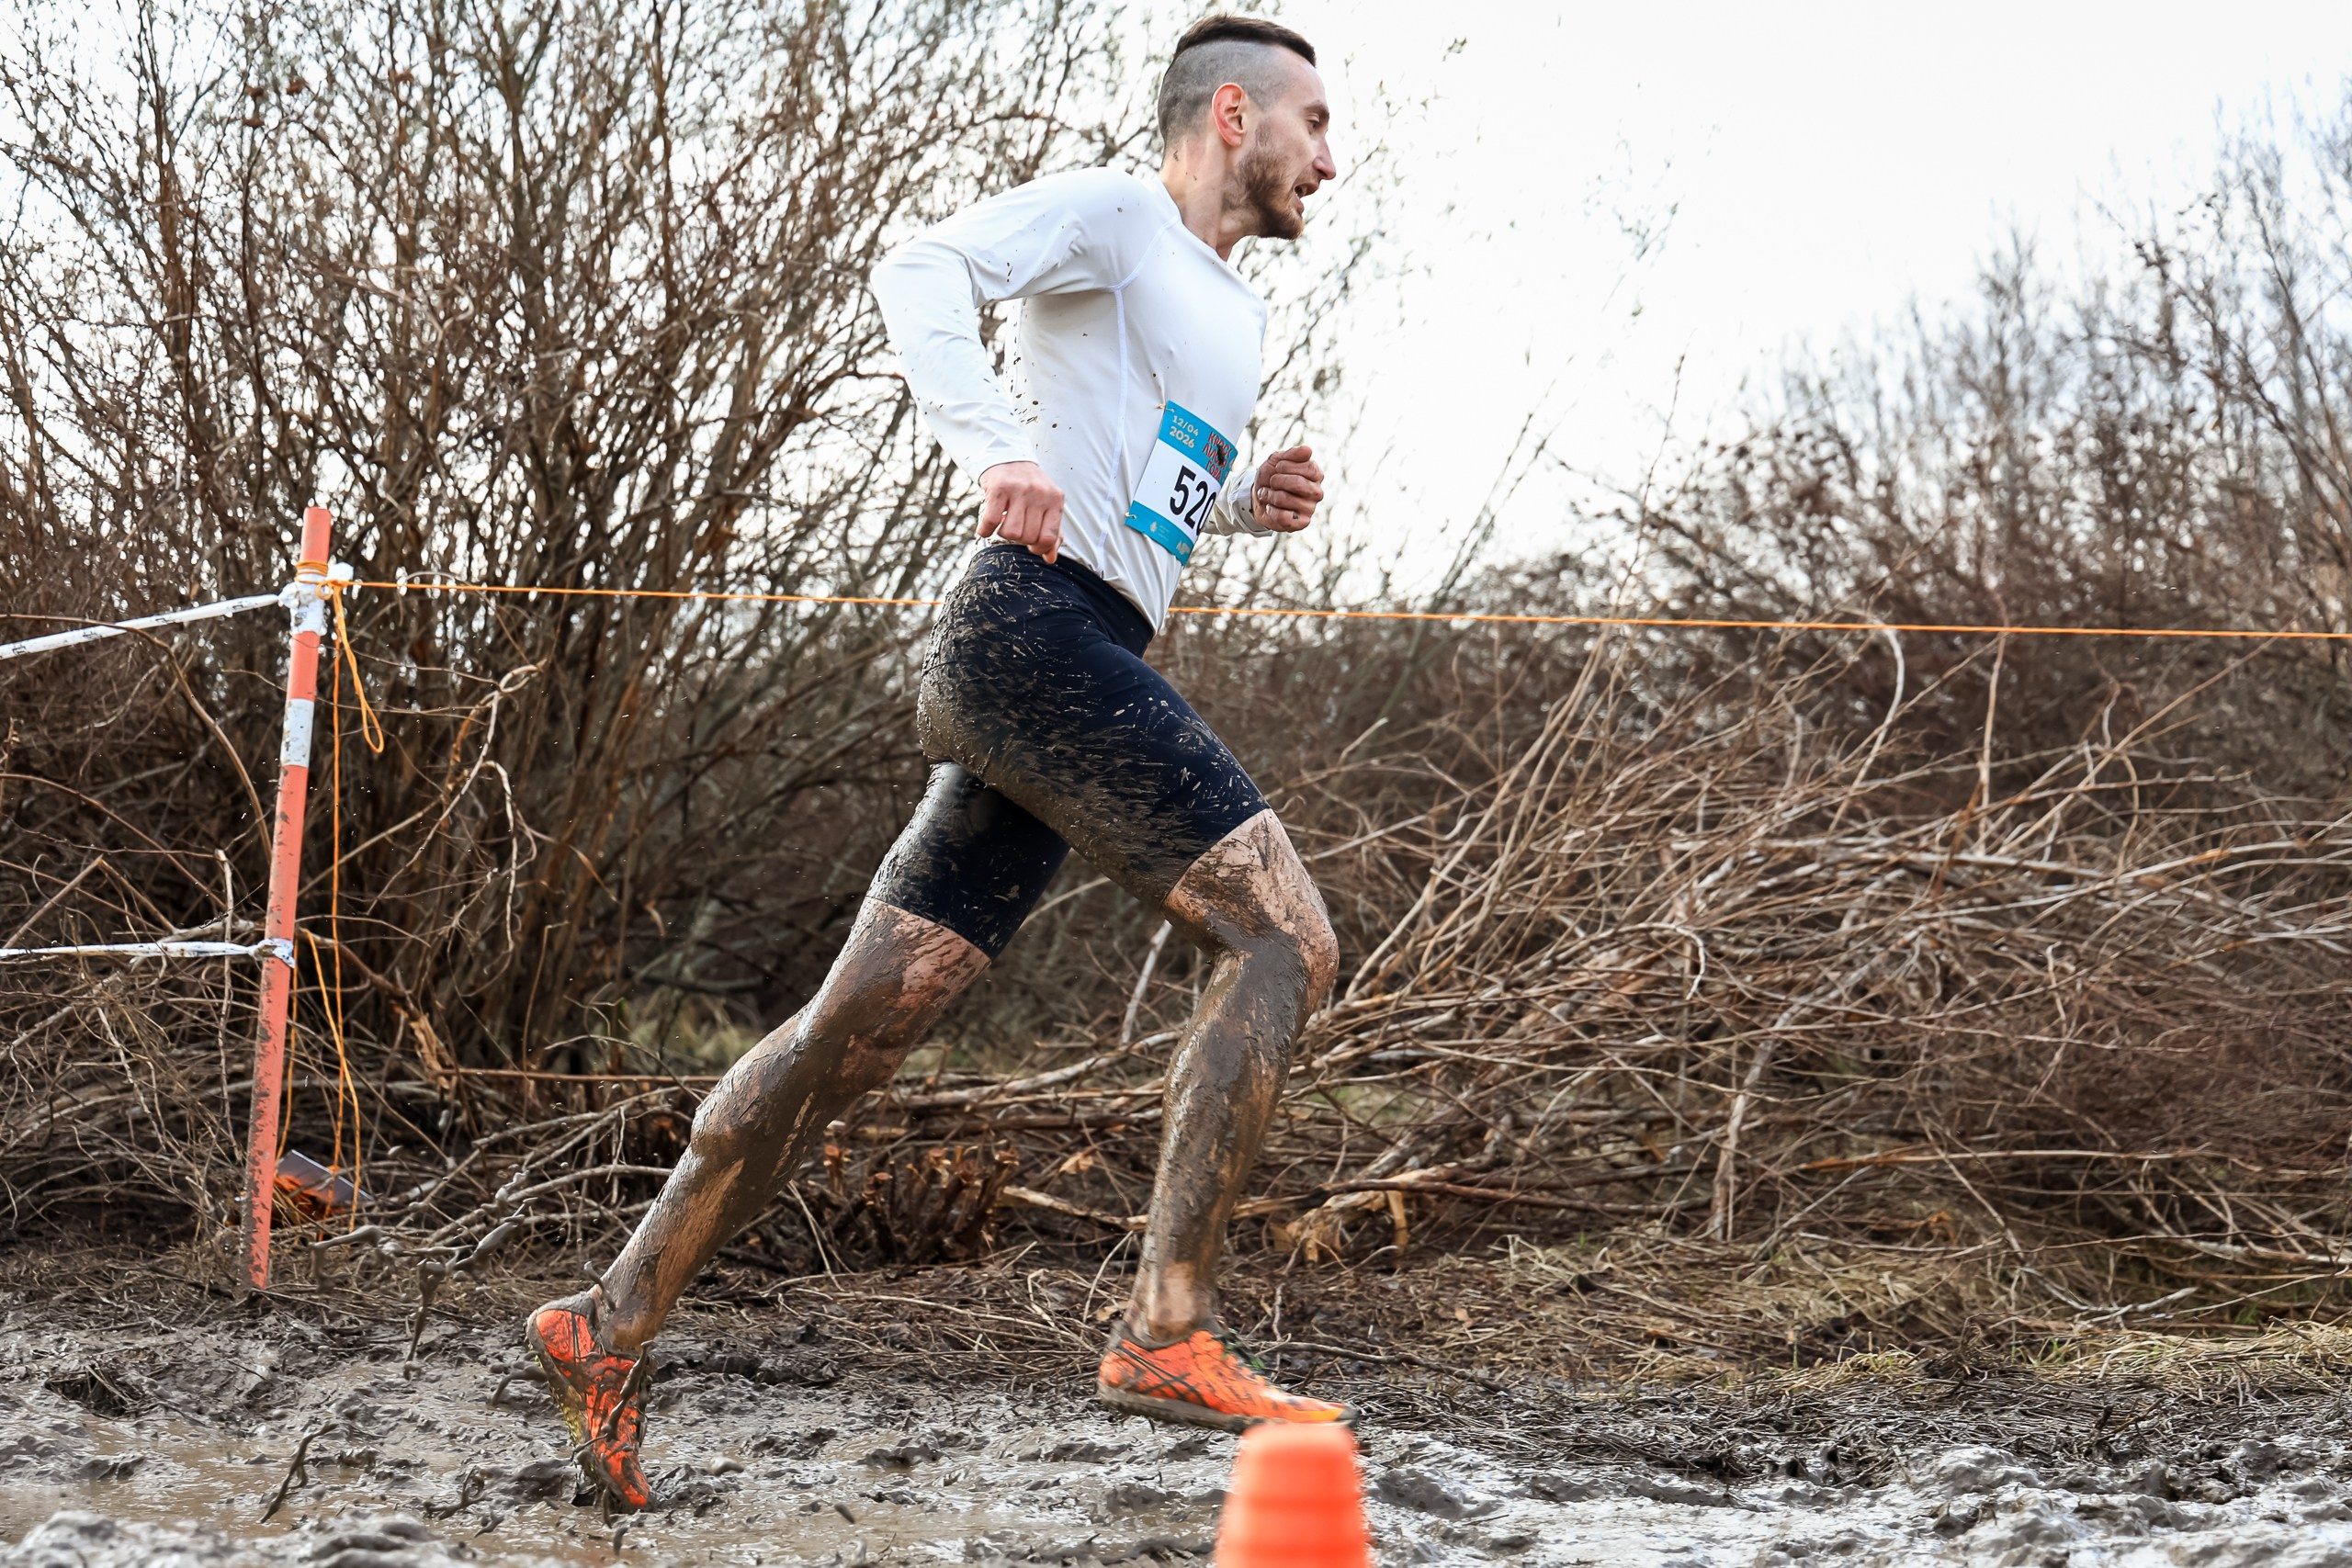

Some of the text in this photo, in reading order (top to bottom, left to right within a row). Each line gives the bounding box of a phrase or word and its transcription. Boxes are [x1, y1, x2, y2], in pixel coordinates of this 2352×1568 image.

[1170, 425, 1194, 448] 2026
[1172, 415, 1199, 436] 12/04
[1204, 460, 1222, 481] ГОРА
[1170, 465, 1216, 536] 520
